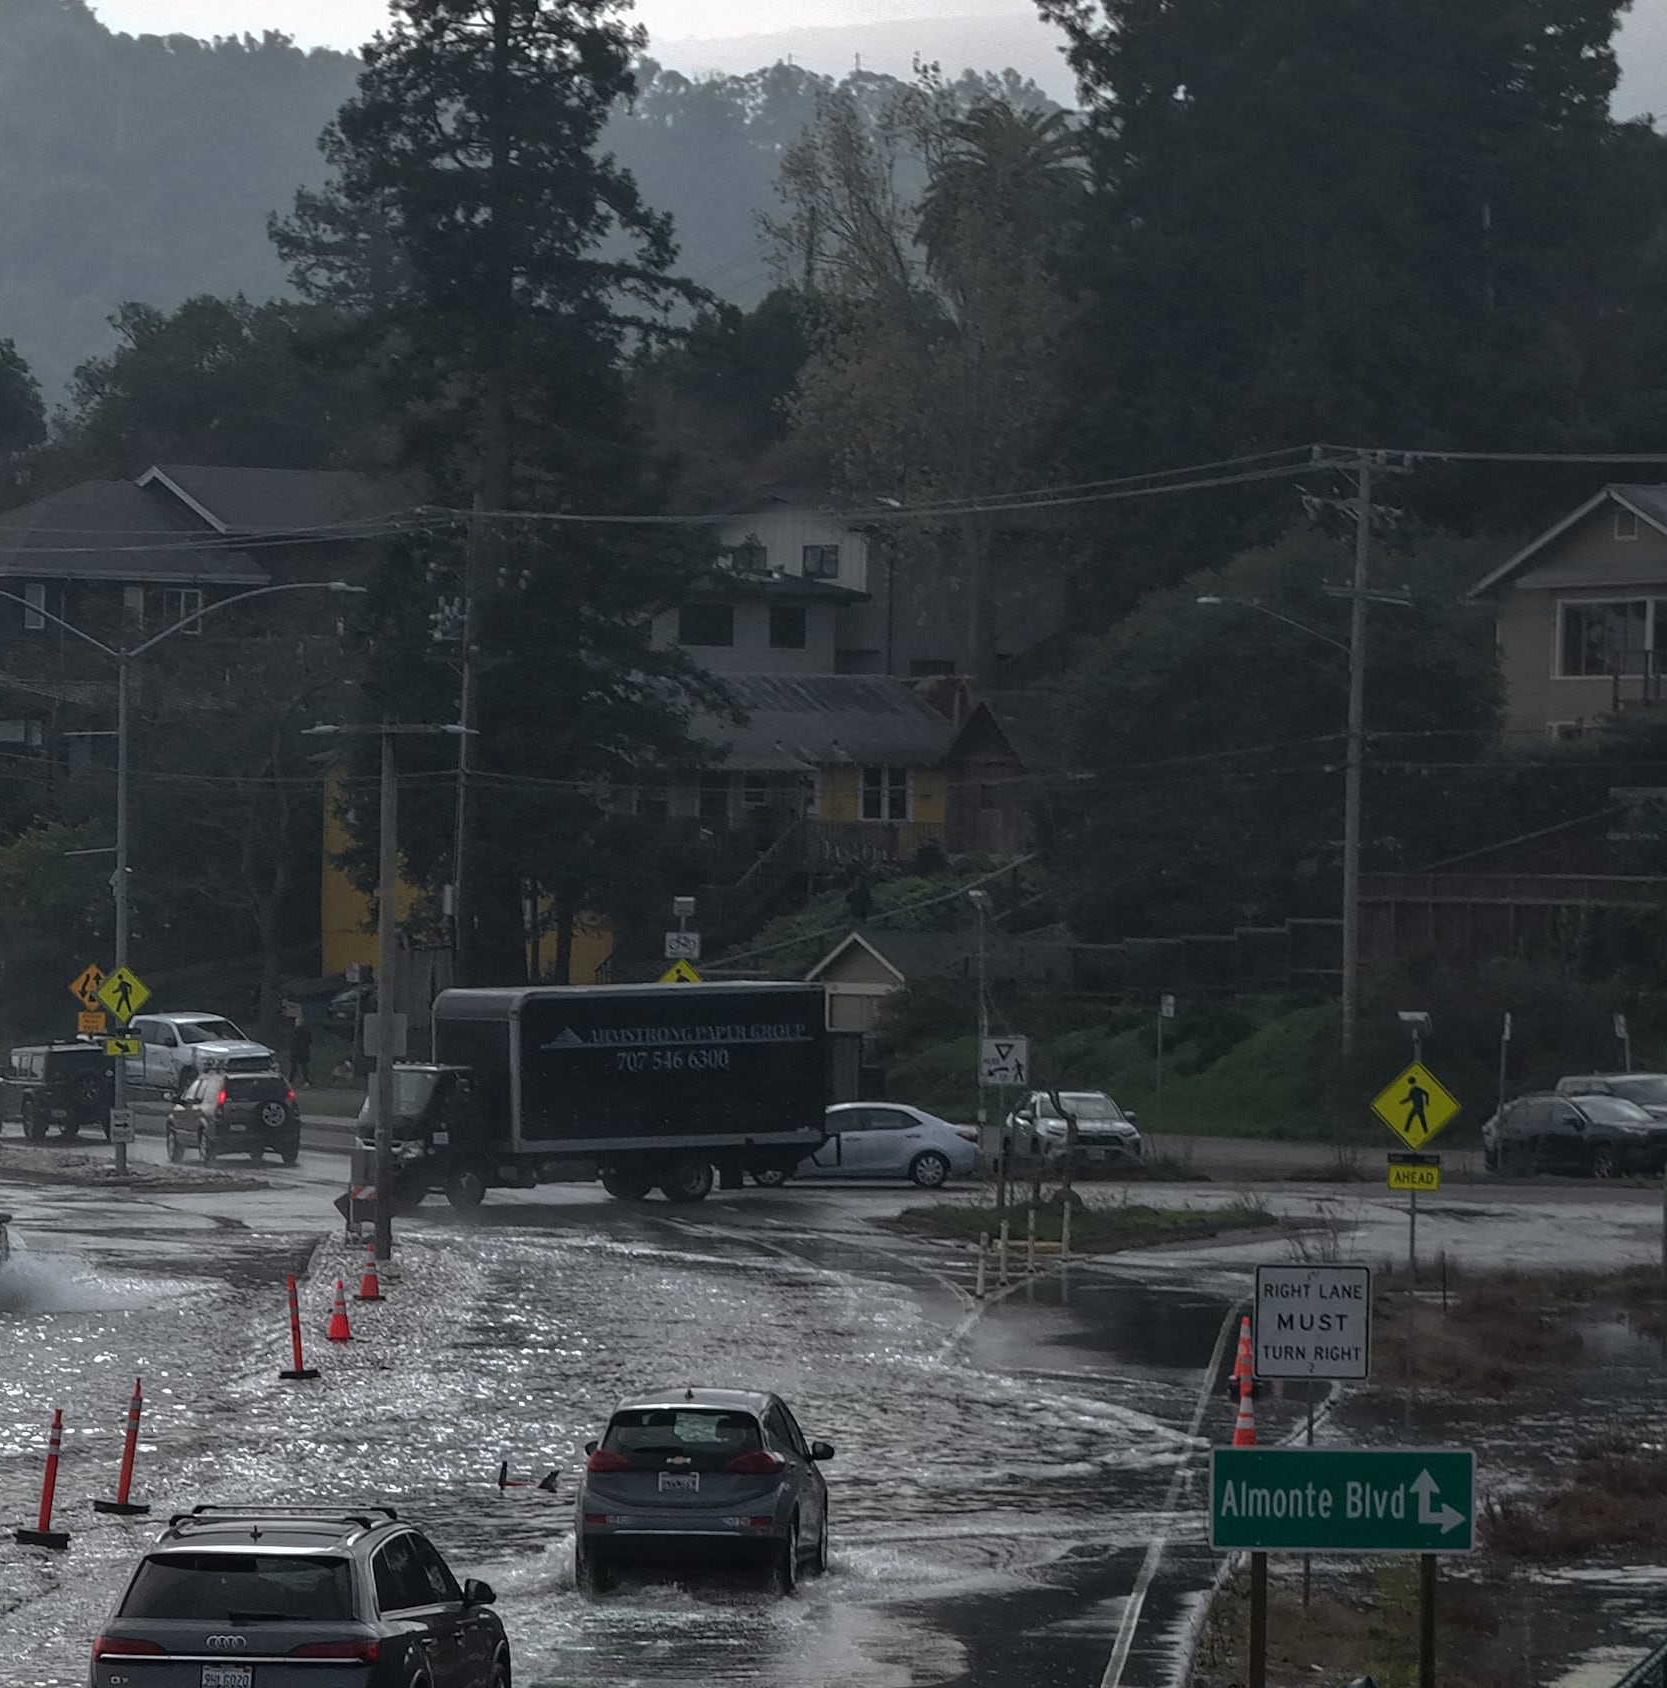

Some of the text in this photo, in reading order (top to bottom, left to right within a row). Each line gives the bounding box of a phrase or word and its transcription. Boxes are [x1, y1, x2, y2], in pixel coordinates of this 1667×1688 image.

[616, 1049, 730, 1071] 707 546 6300
[1393, 1172, 1435, 1185] AHEAD
[1263, 1283, 1363, 1300] RIGHT LANE
[1276, 1314, 1349, 1332] MUST
[1263, 1345, 1362, 1361] TURN RIGHT
[1220, 1479, 1405, 1519] Almonte Blvd
